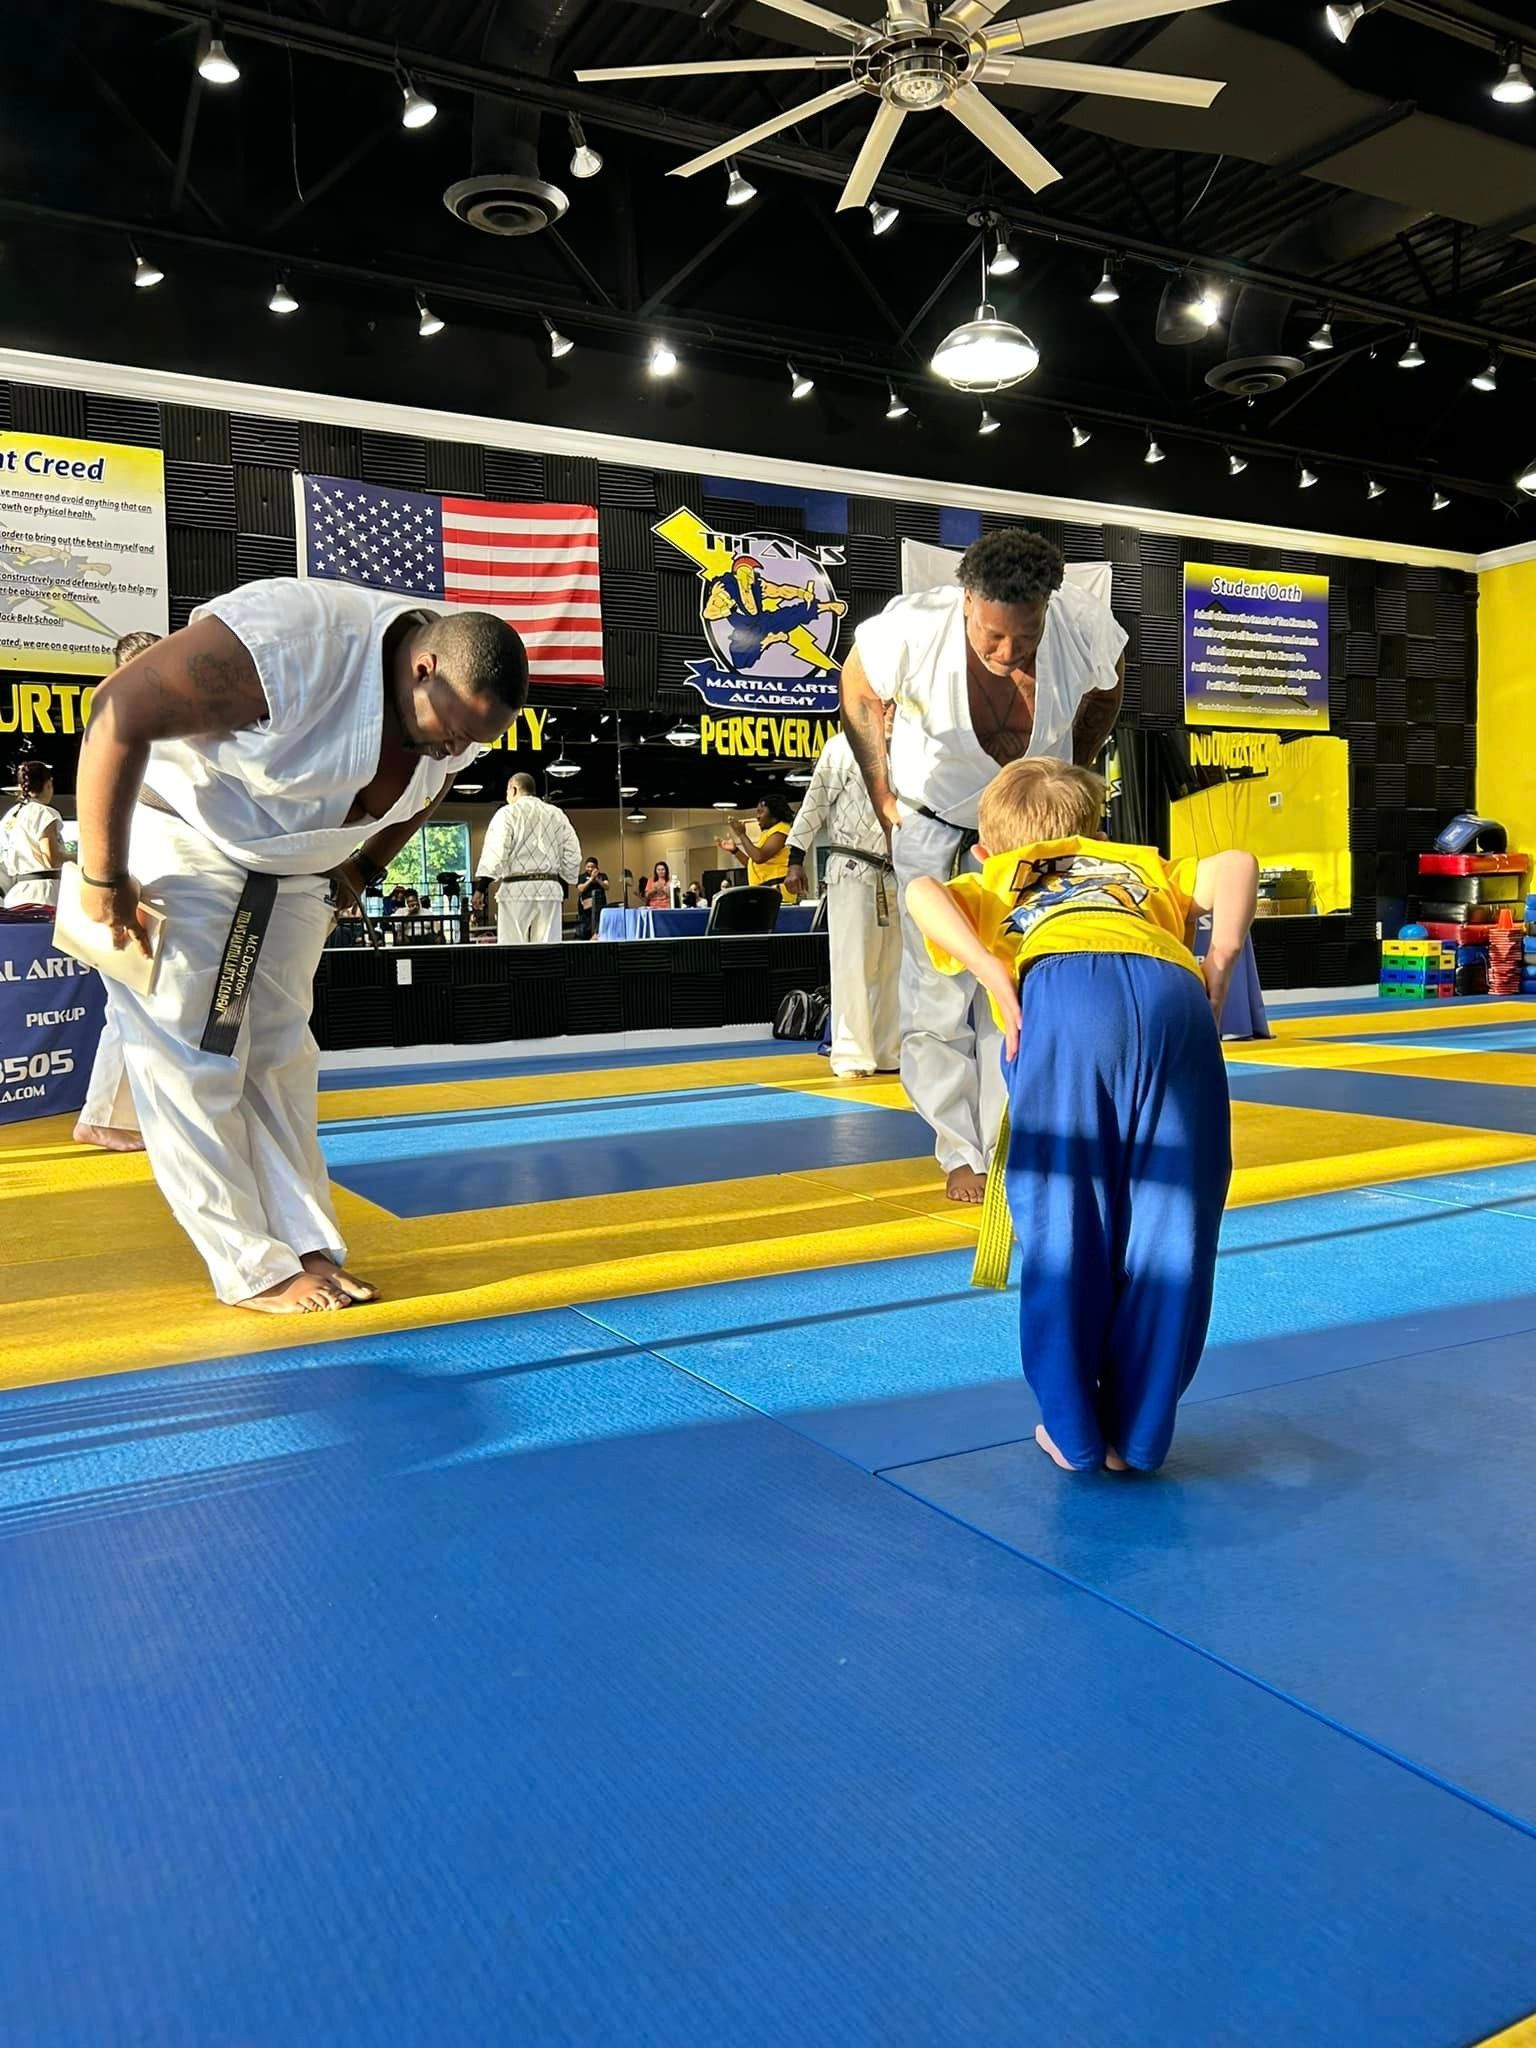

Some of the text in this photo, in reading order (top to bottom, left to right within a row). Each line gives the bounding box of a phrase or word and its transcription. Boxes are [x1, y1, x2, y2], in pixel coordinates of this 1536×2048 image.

[24, 450, 105, 481] Creed
[0, 501, 22, 511] owth
[33, 505, 67, 518] physical
[67, 509, 96, 520] health.
[12, 490, 43, 500] manner
[44, 493, 60, 502] and
[61, 495, 83, 504] avoid
[85, 498, 119, 512] anything
[121, 501, 137, 511] that
[138, 504, 152, 512] can
[1, 530, 154, 554] order to bring out the best in myself and
[699, 531, 847, 566] TITANS
[0, 572, 53, 586] onstructively
[55, 577, 70, 586] and
[118, 583, 127, 591] to
[128, 584, 144, 597] help
[145, 586, 158, 598] my
[8, 586, 18, 595] be
[19, 588, 51, 599] abusive
[1212, 577, 1303, 603] Student Oath
[17, 613, 33, 623] Belt
[23, 640, 35, 648] we
[36, 641, 49, 649] are
[50, 642, 61, 650] on
[69, 643, 90, 655] quest
[91, 644, 99, 652] to
[101, 645, 111, 653] be
[706, 678, 838, 695] MARTIAL ARTS
[729, 692, 817, 706] ACADEMY
[234, 955, 254, 997] Drayton
[0, 1049, 74, 1084] 505
